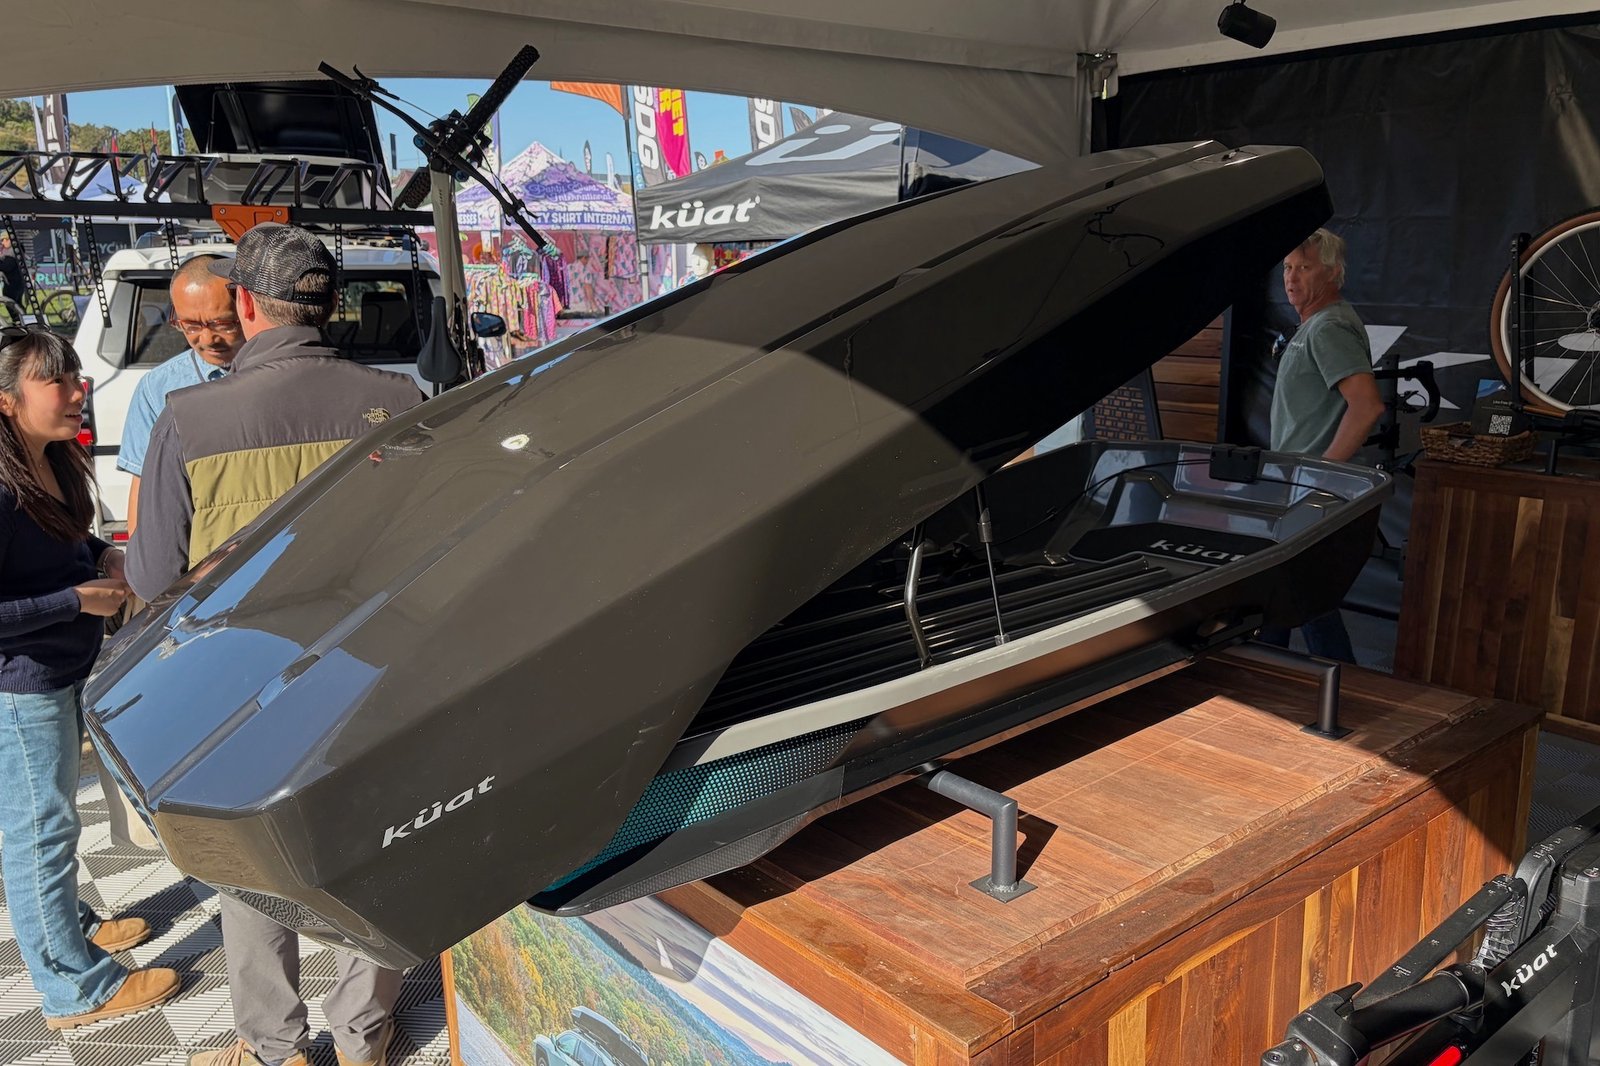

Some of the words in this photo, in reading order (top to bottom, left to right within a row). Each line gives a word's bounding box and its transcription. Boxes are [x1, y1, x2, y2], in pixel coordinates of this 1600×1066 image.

[551, 212, 582, 224] SHIRT
[584, 213, 634, 225] INTERNAT
[650, 198, 757, 230] küat
[382, 775, 496, 849] küat
[1500, 943, 1559, 998] küat
